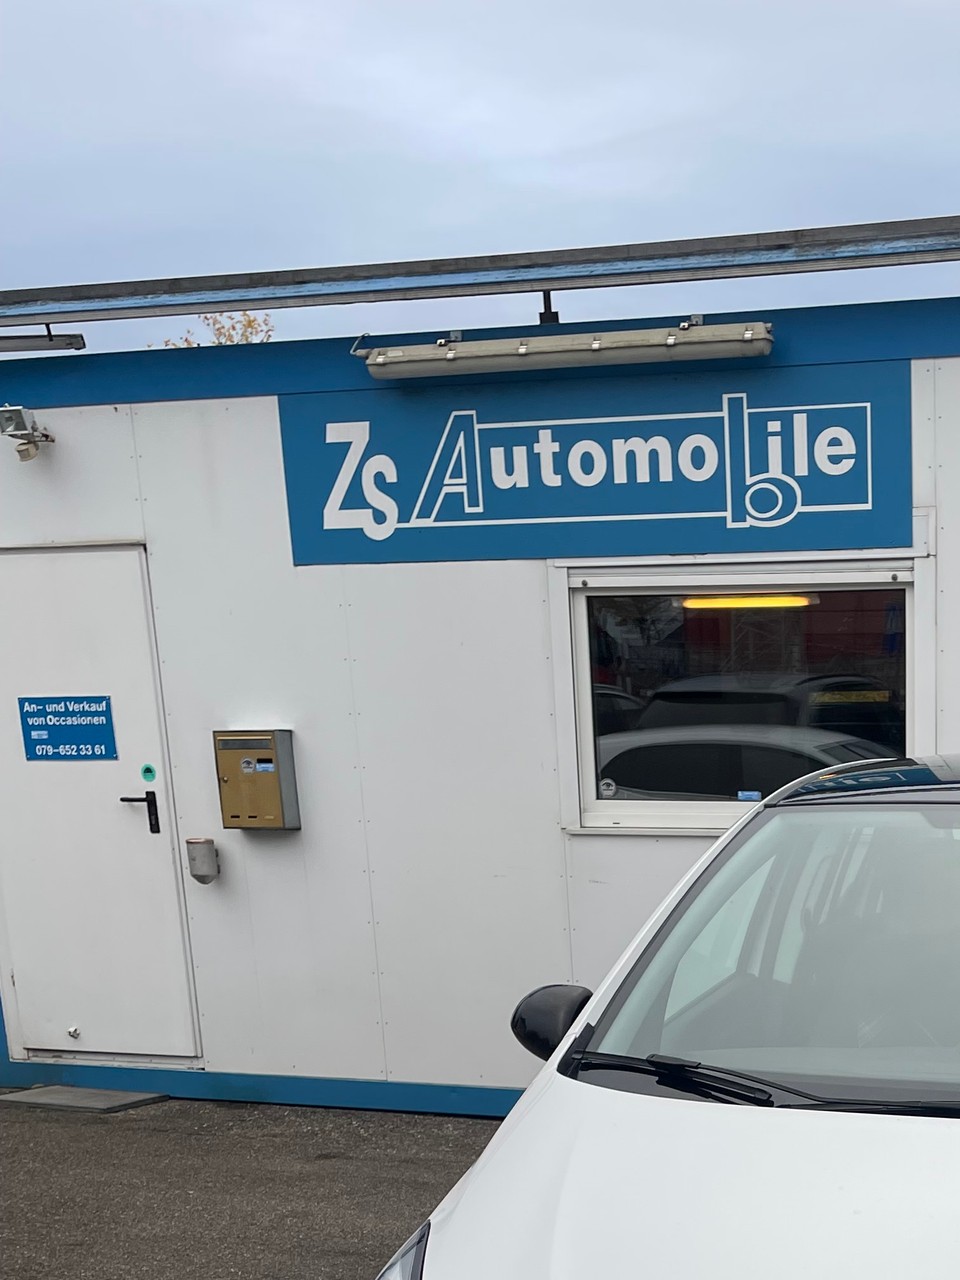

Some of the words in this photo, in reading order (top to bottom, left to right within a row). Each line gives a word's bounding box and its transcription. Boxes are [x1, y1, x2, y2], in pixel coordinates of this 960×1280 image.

[410, 393, 857, 528] Automobile
[24, 702, 43, 712] An-
[45, 702, 65, 712] und
[66, 701, 106, 711] Verkauf
[27, 717, 45, 725] von
[46, 714, 106, 725] Occasionen
[79, 745, 92, 755] 33
[94, 744, 106, 755] 61
